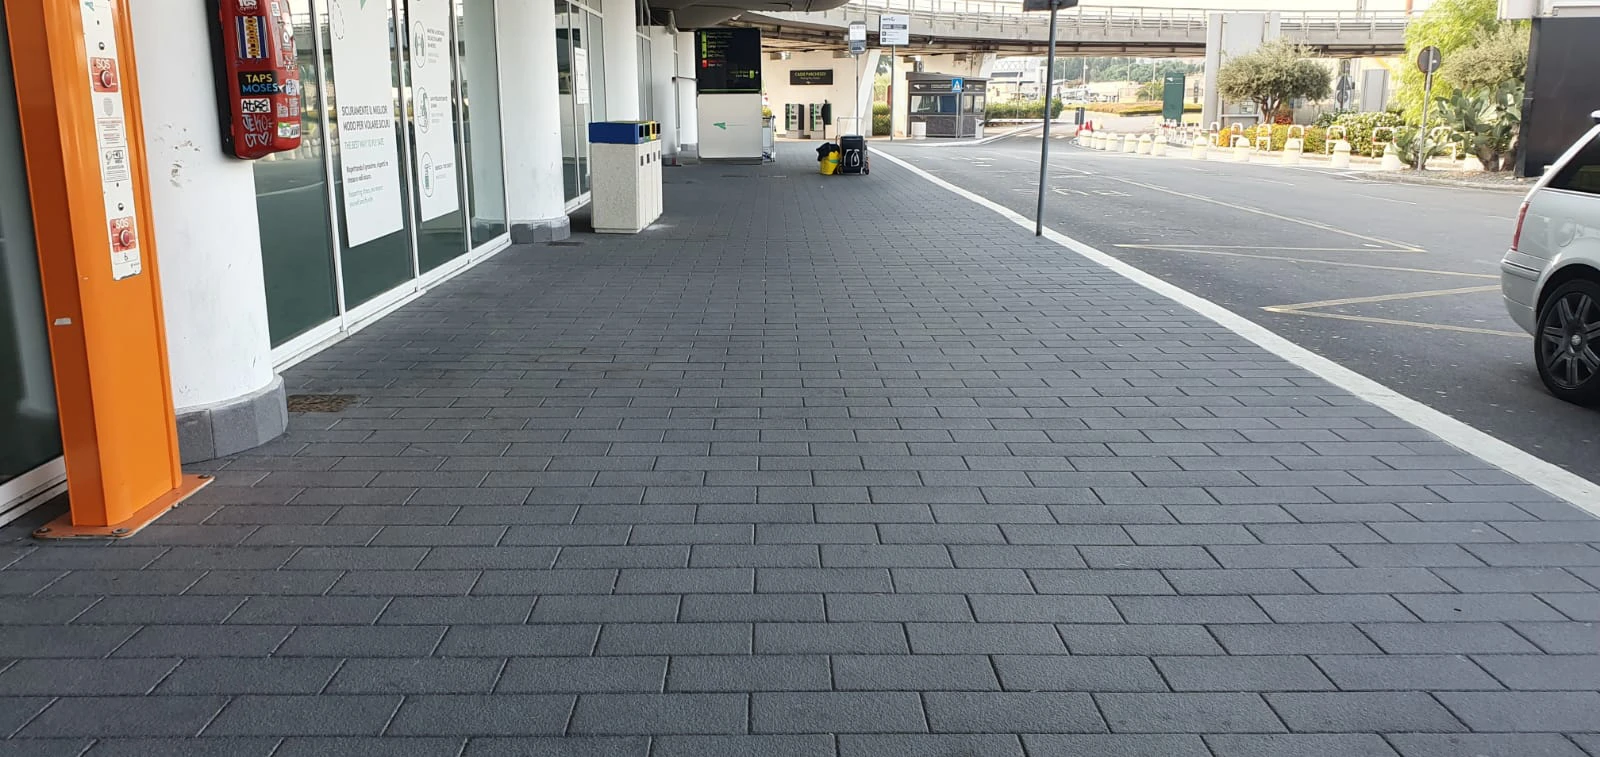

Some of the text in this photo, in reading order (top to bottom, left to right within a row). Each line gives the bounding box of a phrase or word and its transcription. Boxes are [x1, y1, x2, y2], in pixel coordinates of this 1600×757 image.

[96, 58, 111, 69] SOS
[246, 73, 273, 83] TAPS
[242, 83, 278, 93] MOSES
[115, 219, 129, 229] SOS
